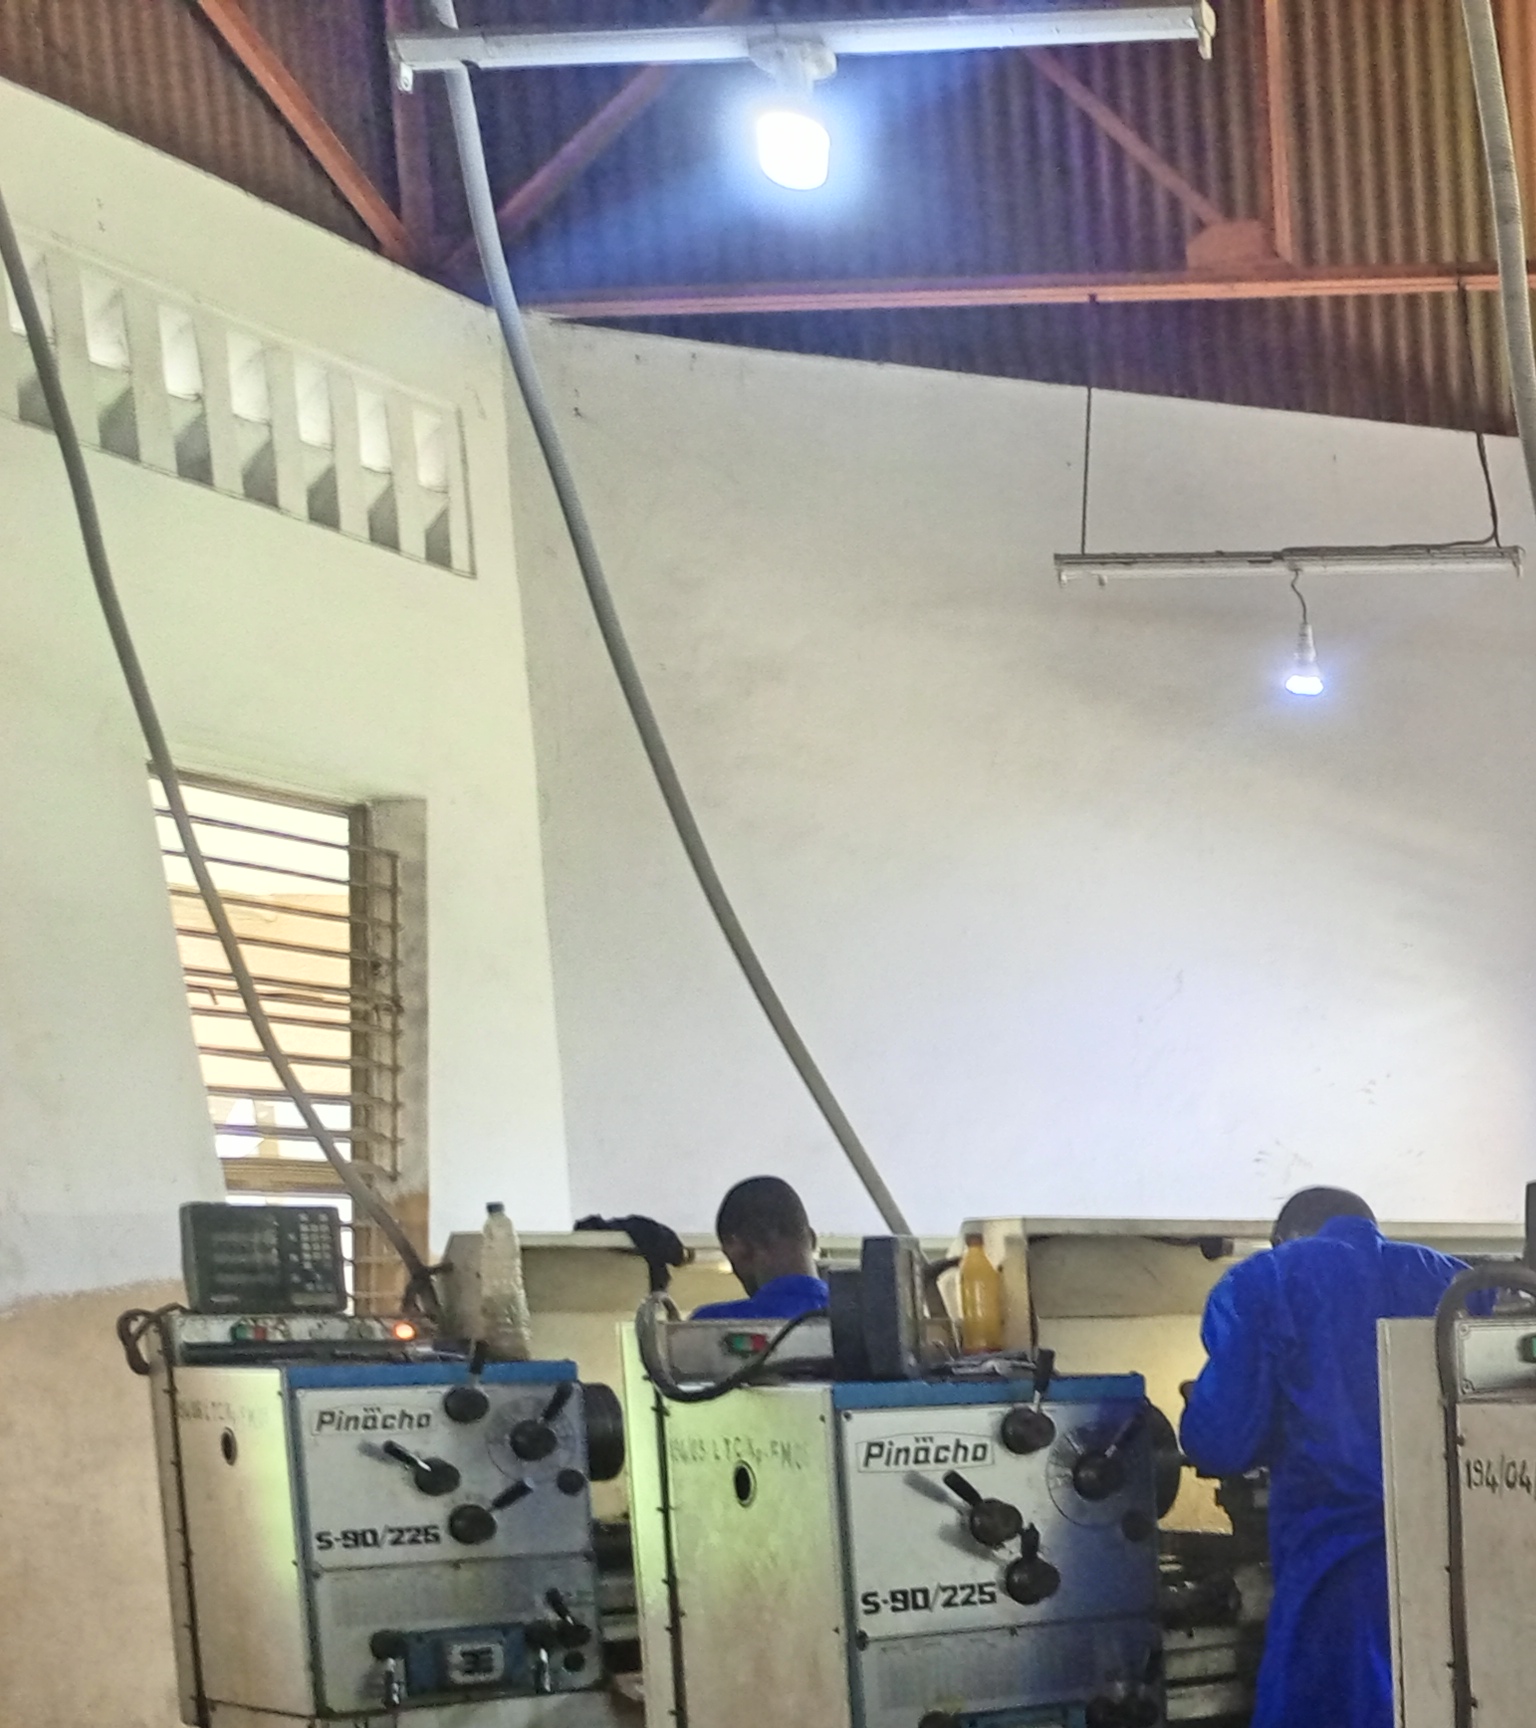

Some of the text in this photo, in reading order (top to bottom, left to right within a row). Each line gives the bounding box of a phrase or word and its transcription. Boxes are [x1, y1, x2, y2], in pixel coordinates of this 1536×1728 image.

[315, 1408, 432, 1433] Pinacho
[863, 1437, 989, 1468] Pinacho
[861, 1582, 998, 1615] S-90/225
